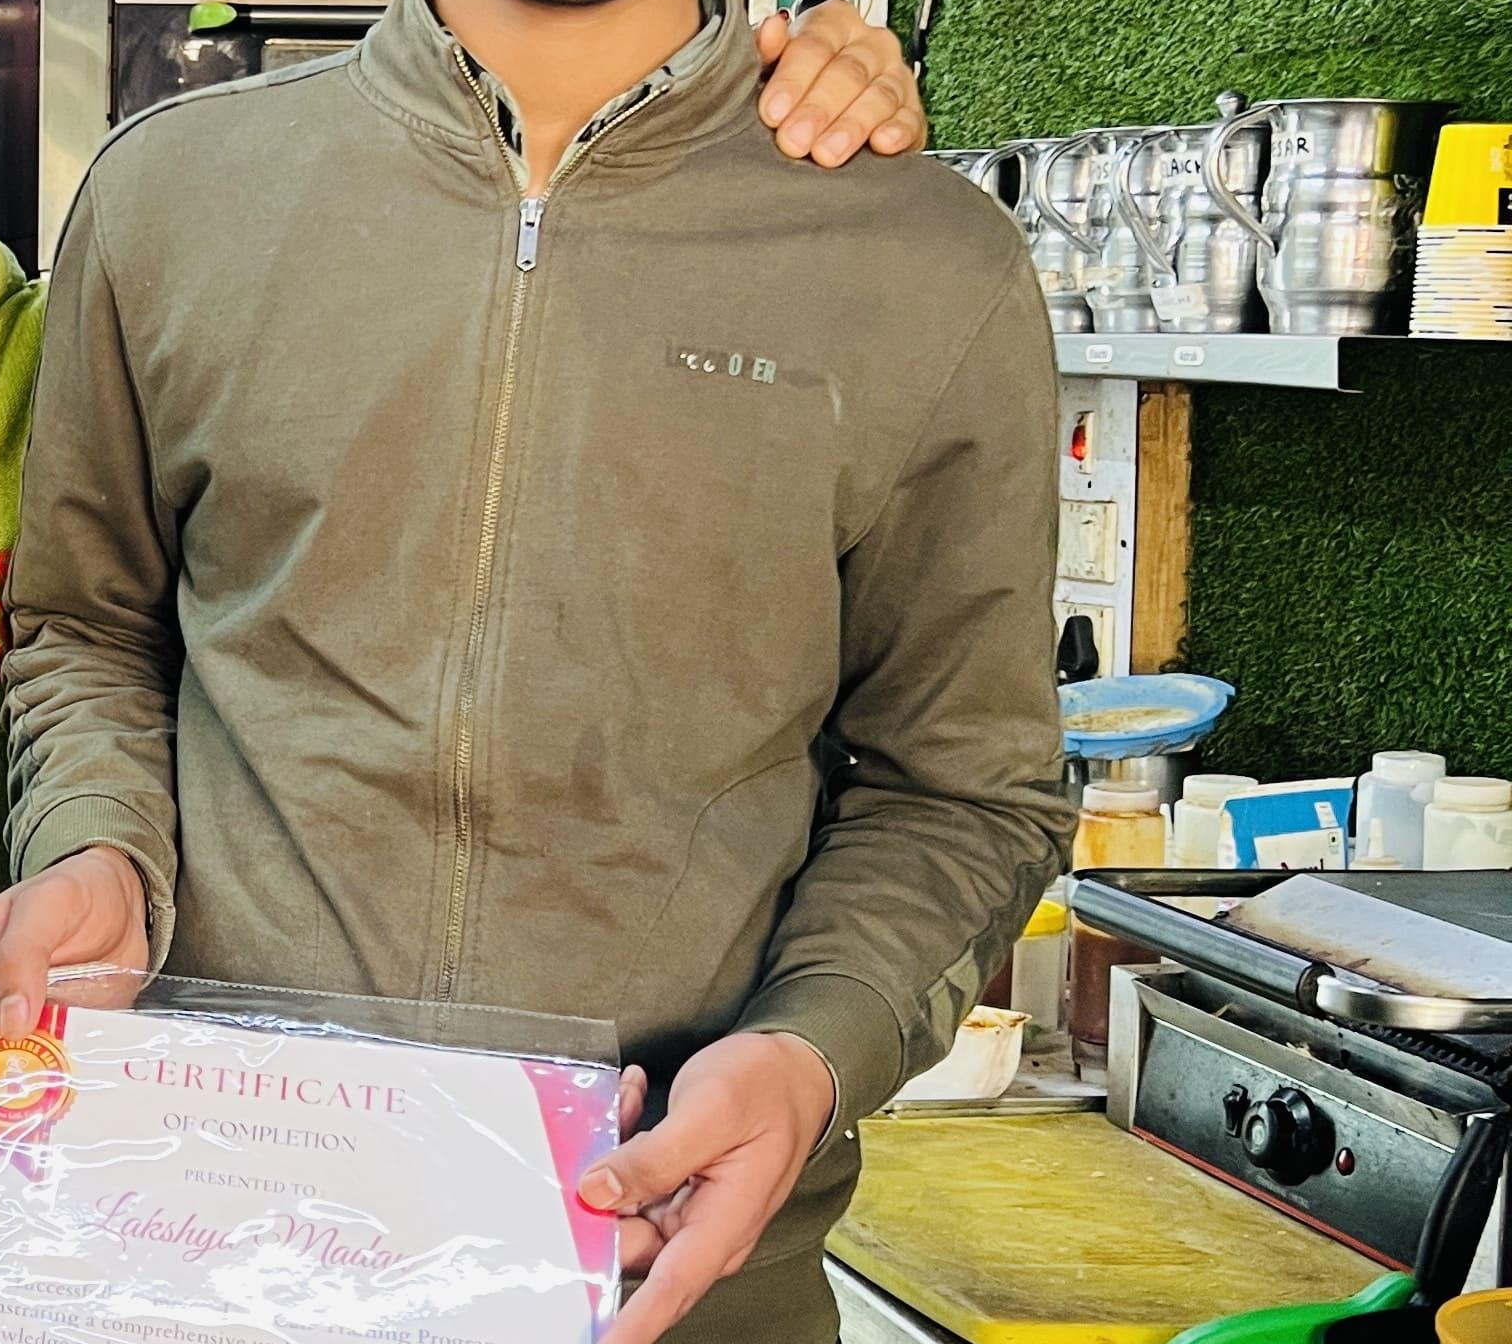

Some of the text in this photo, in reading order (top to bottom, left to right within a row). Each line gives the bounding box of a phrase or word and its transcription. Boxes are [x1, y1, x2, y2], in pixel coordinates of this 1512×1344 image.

[122, 1057, 407, 1115] CERTIFICATE
[162, 1112, 359, 1153] OF COMPLETION
[184, 1168, 285, 1194] PRESENTED
[85, 1316, 95, 1328] a
